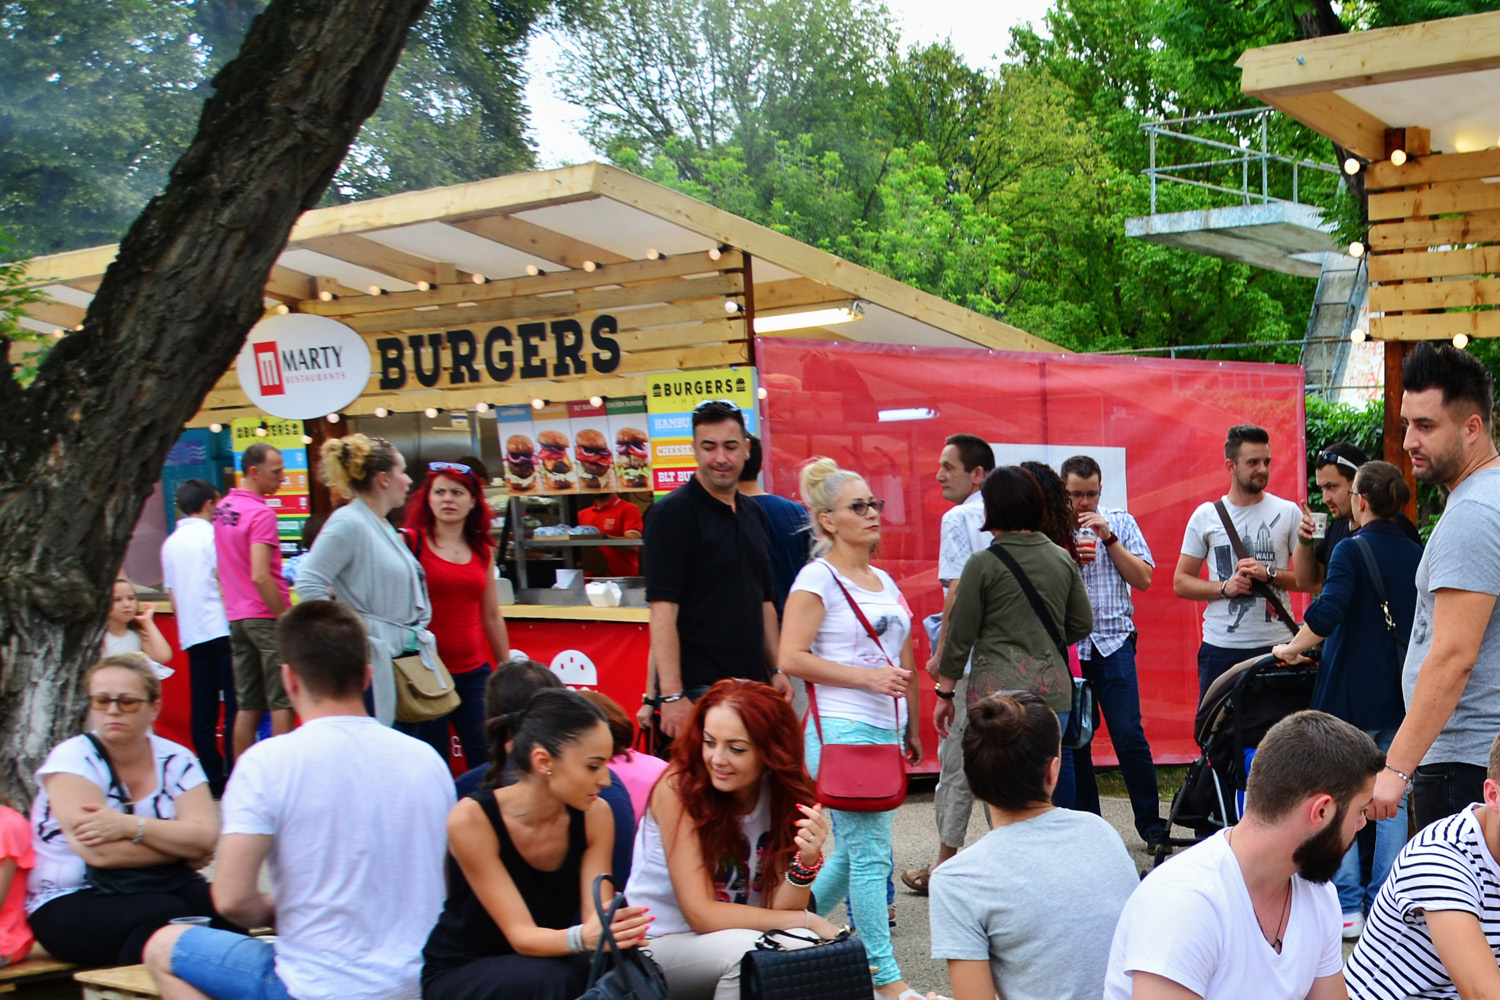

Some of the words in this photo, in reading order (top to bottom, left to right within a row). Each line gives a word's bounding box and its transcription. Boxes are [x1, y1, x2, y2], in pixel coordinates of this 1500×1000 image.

[376, 314, 621, 390] BURGERS
[282, 345, 343, 372] MARTY
[663, 379, 733, 397] BURGERS
[654, 417, 692, 429] HAMBU
[656, 445, 695, 456] CHEESE
[657, 471, 676, 482] BLT
[1255, 552, 1274, 560] WALK
